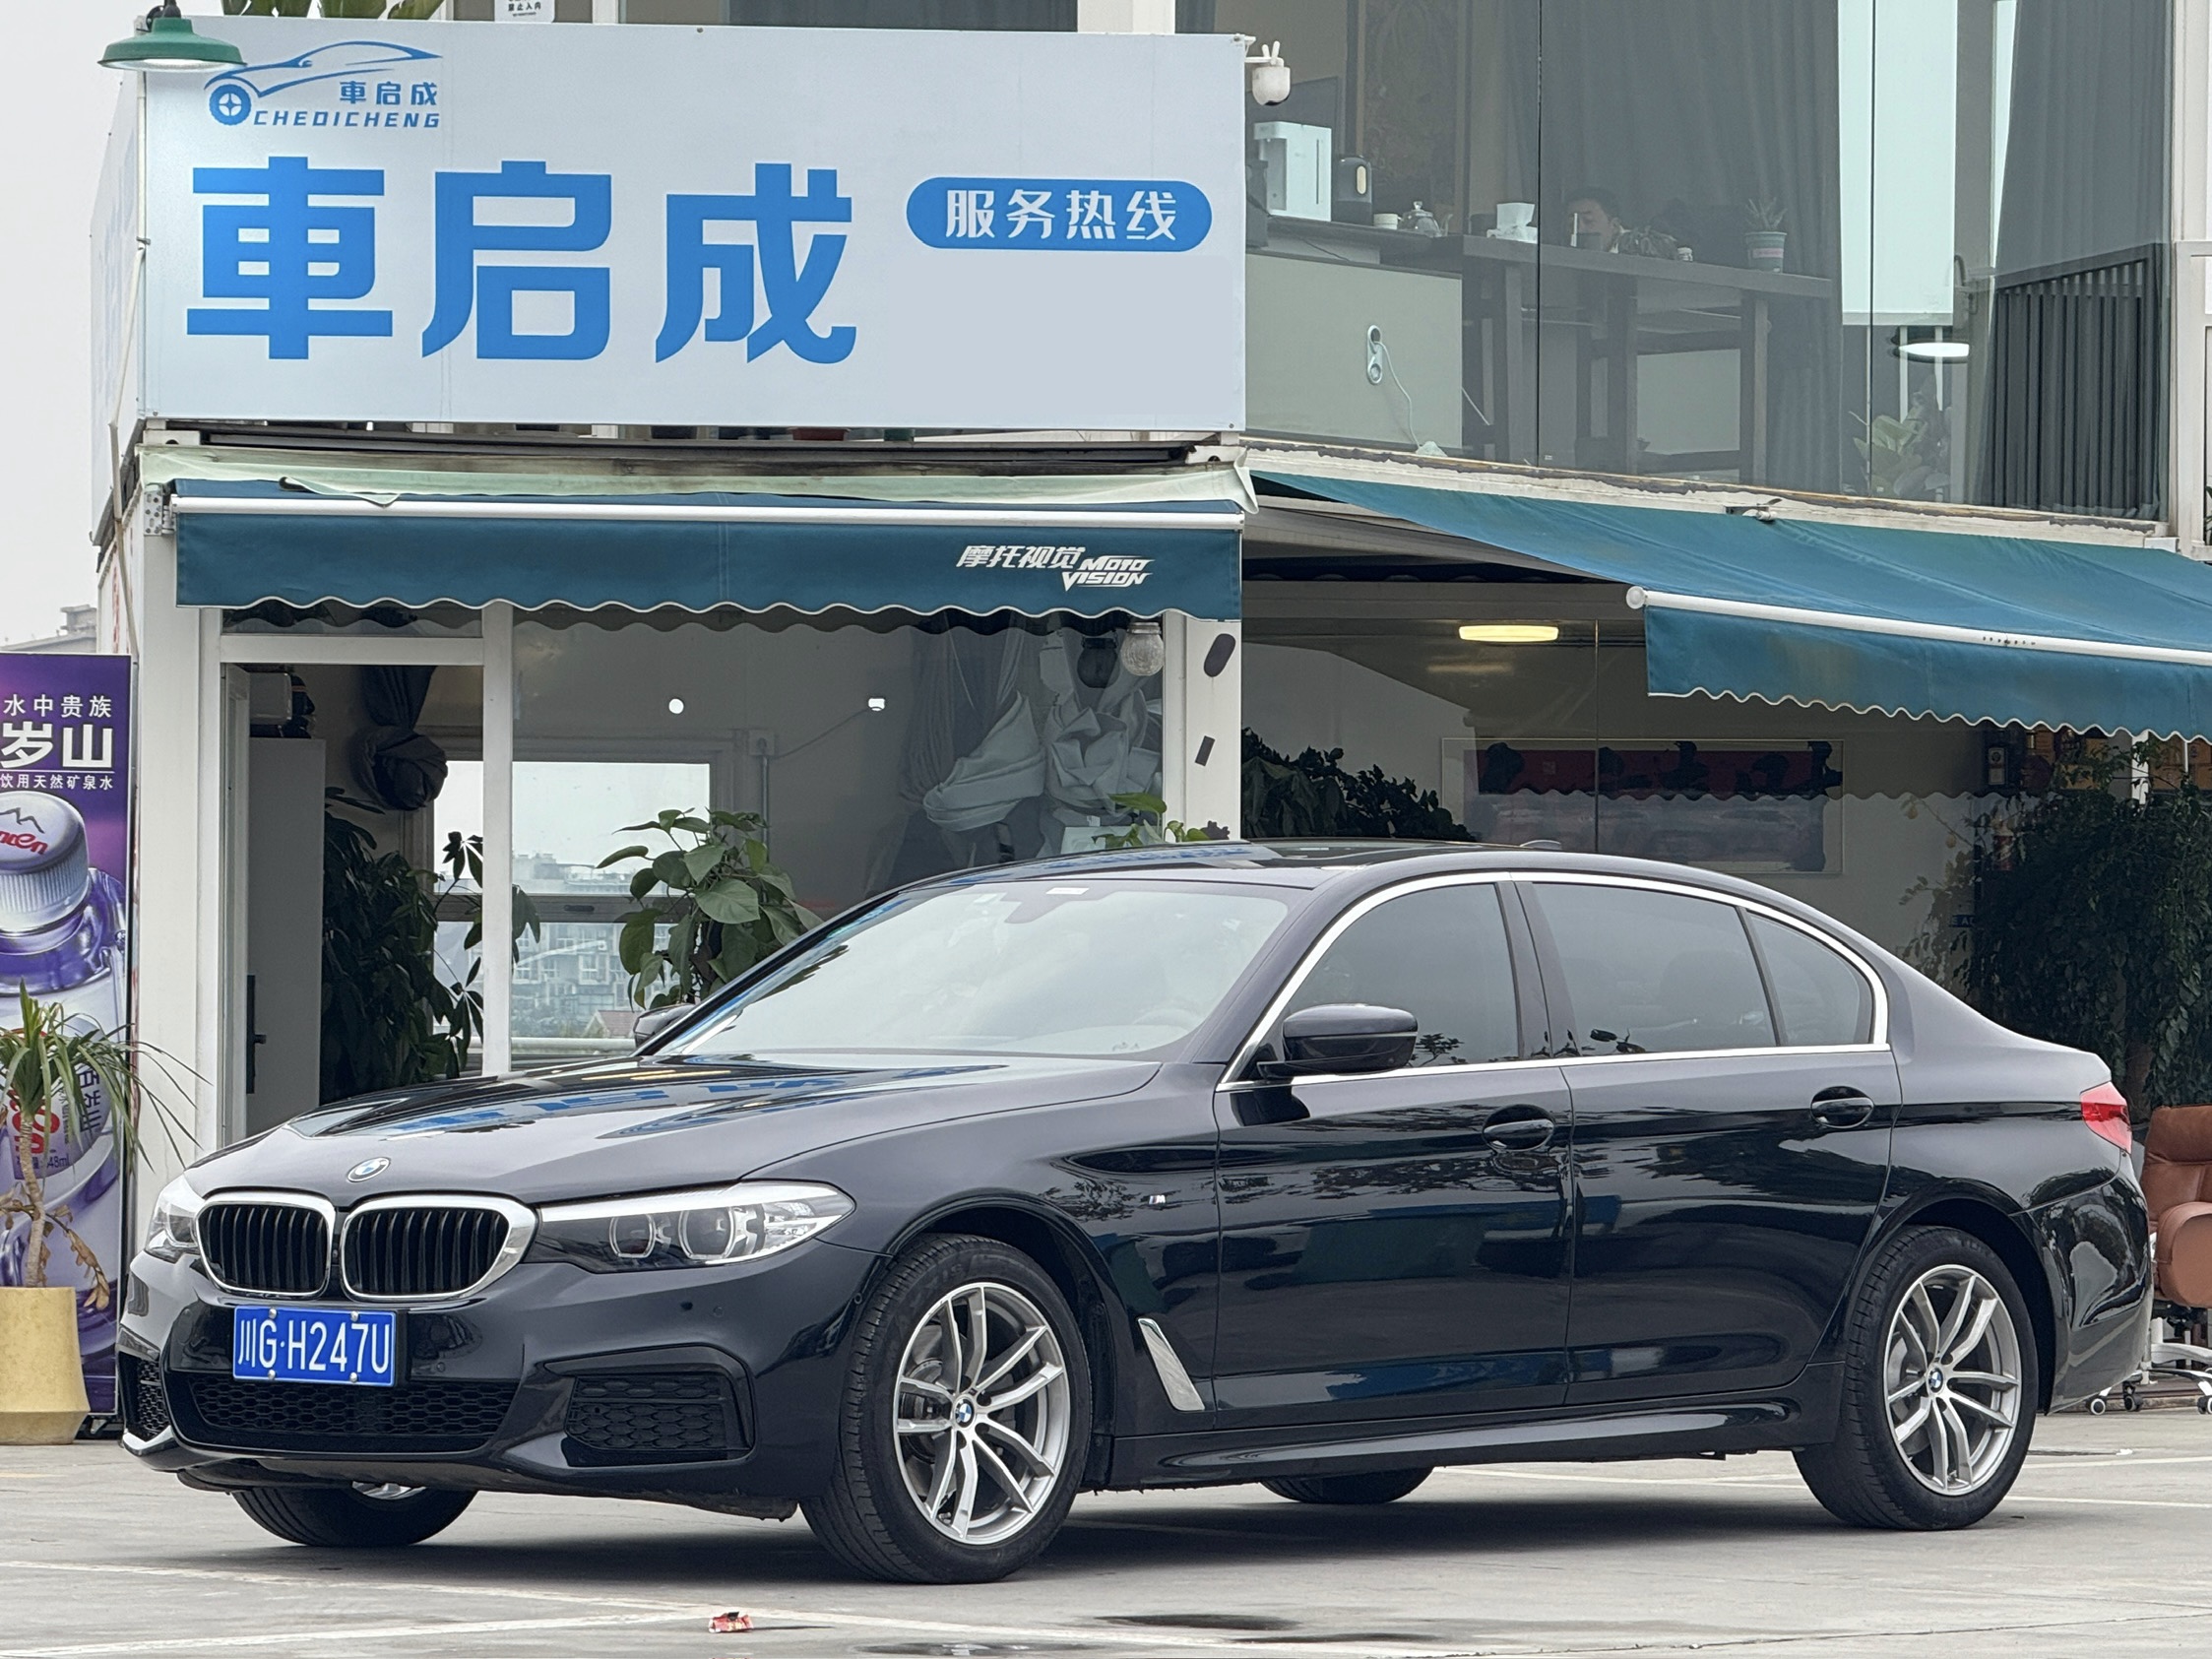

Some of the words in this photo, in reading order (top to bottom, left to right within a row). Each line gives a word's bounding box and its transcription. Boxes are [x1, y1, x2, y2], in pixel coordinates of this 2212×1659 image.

[340, 81, 438, 105] 車启成
[945, 189, 1177, 241] 服务热线
[187, 157, 856, 364] 車启成
[956, 544, 1086, 569] 摩托视觉
[4, 694, 112, 718] 水中贵族
[0, 721, 113, 769] 岁山
[237, 1318, 390, 1374] 川G·H247U
